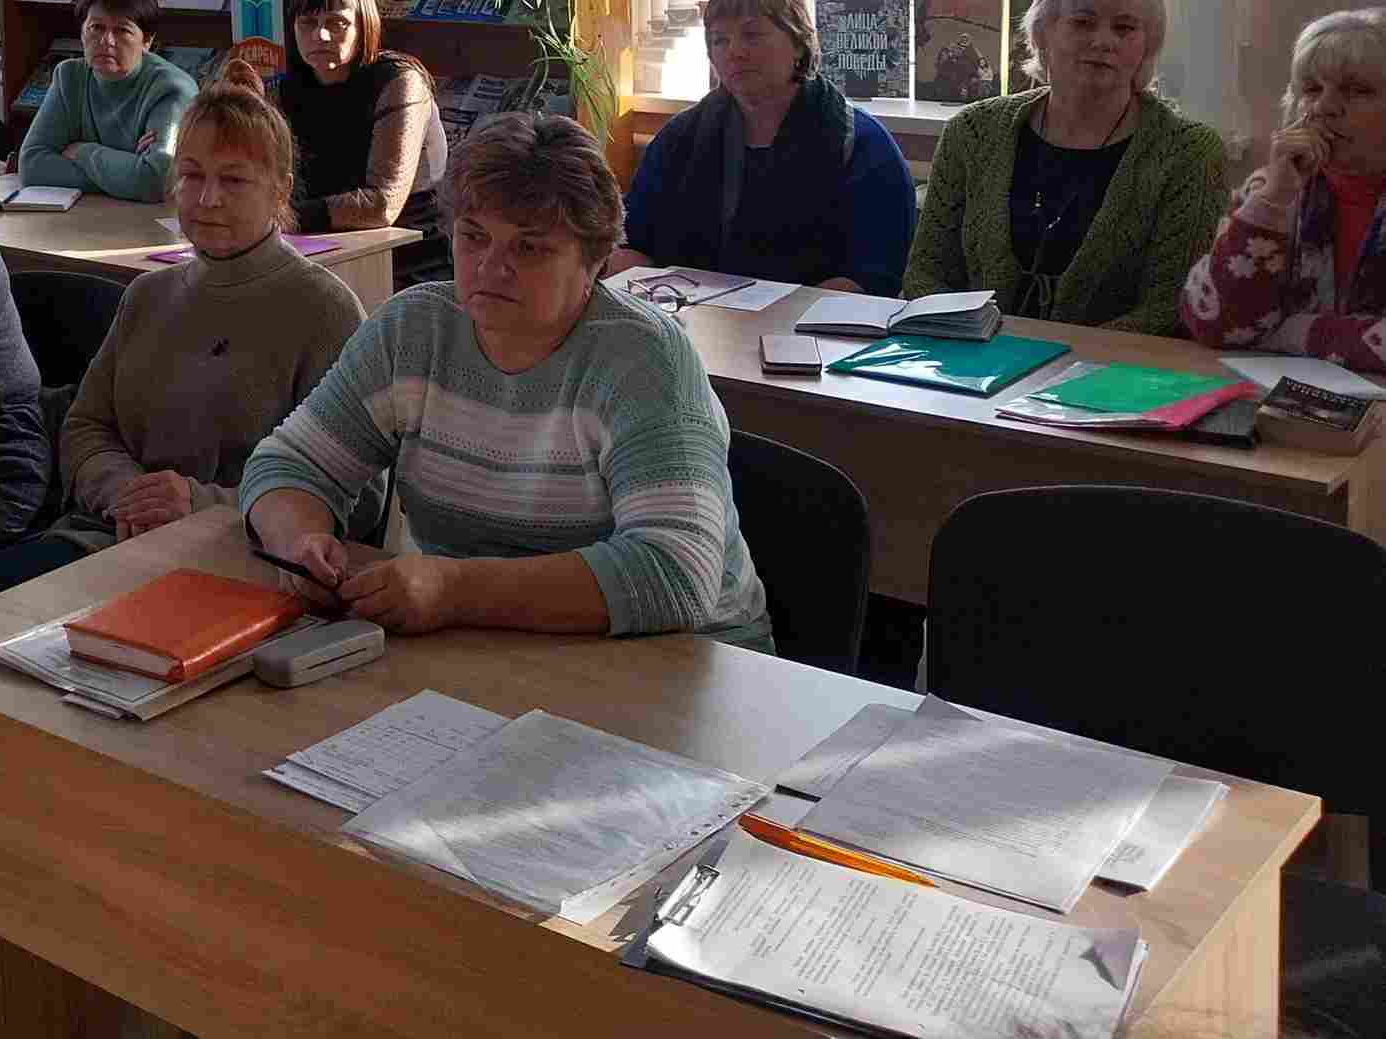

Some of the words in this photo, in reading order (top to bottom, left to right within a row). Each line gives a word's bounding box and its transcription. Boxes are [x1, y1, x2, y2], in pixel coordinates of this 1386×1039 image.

[846, 13, 878, 31] ЛИЦА
[837, 32, 888, 49] ВЕЛИКОЙ
[838, 53, 887, 72] ПОБЕДЫ
